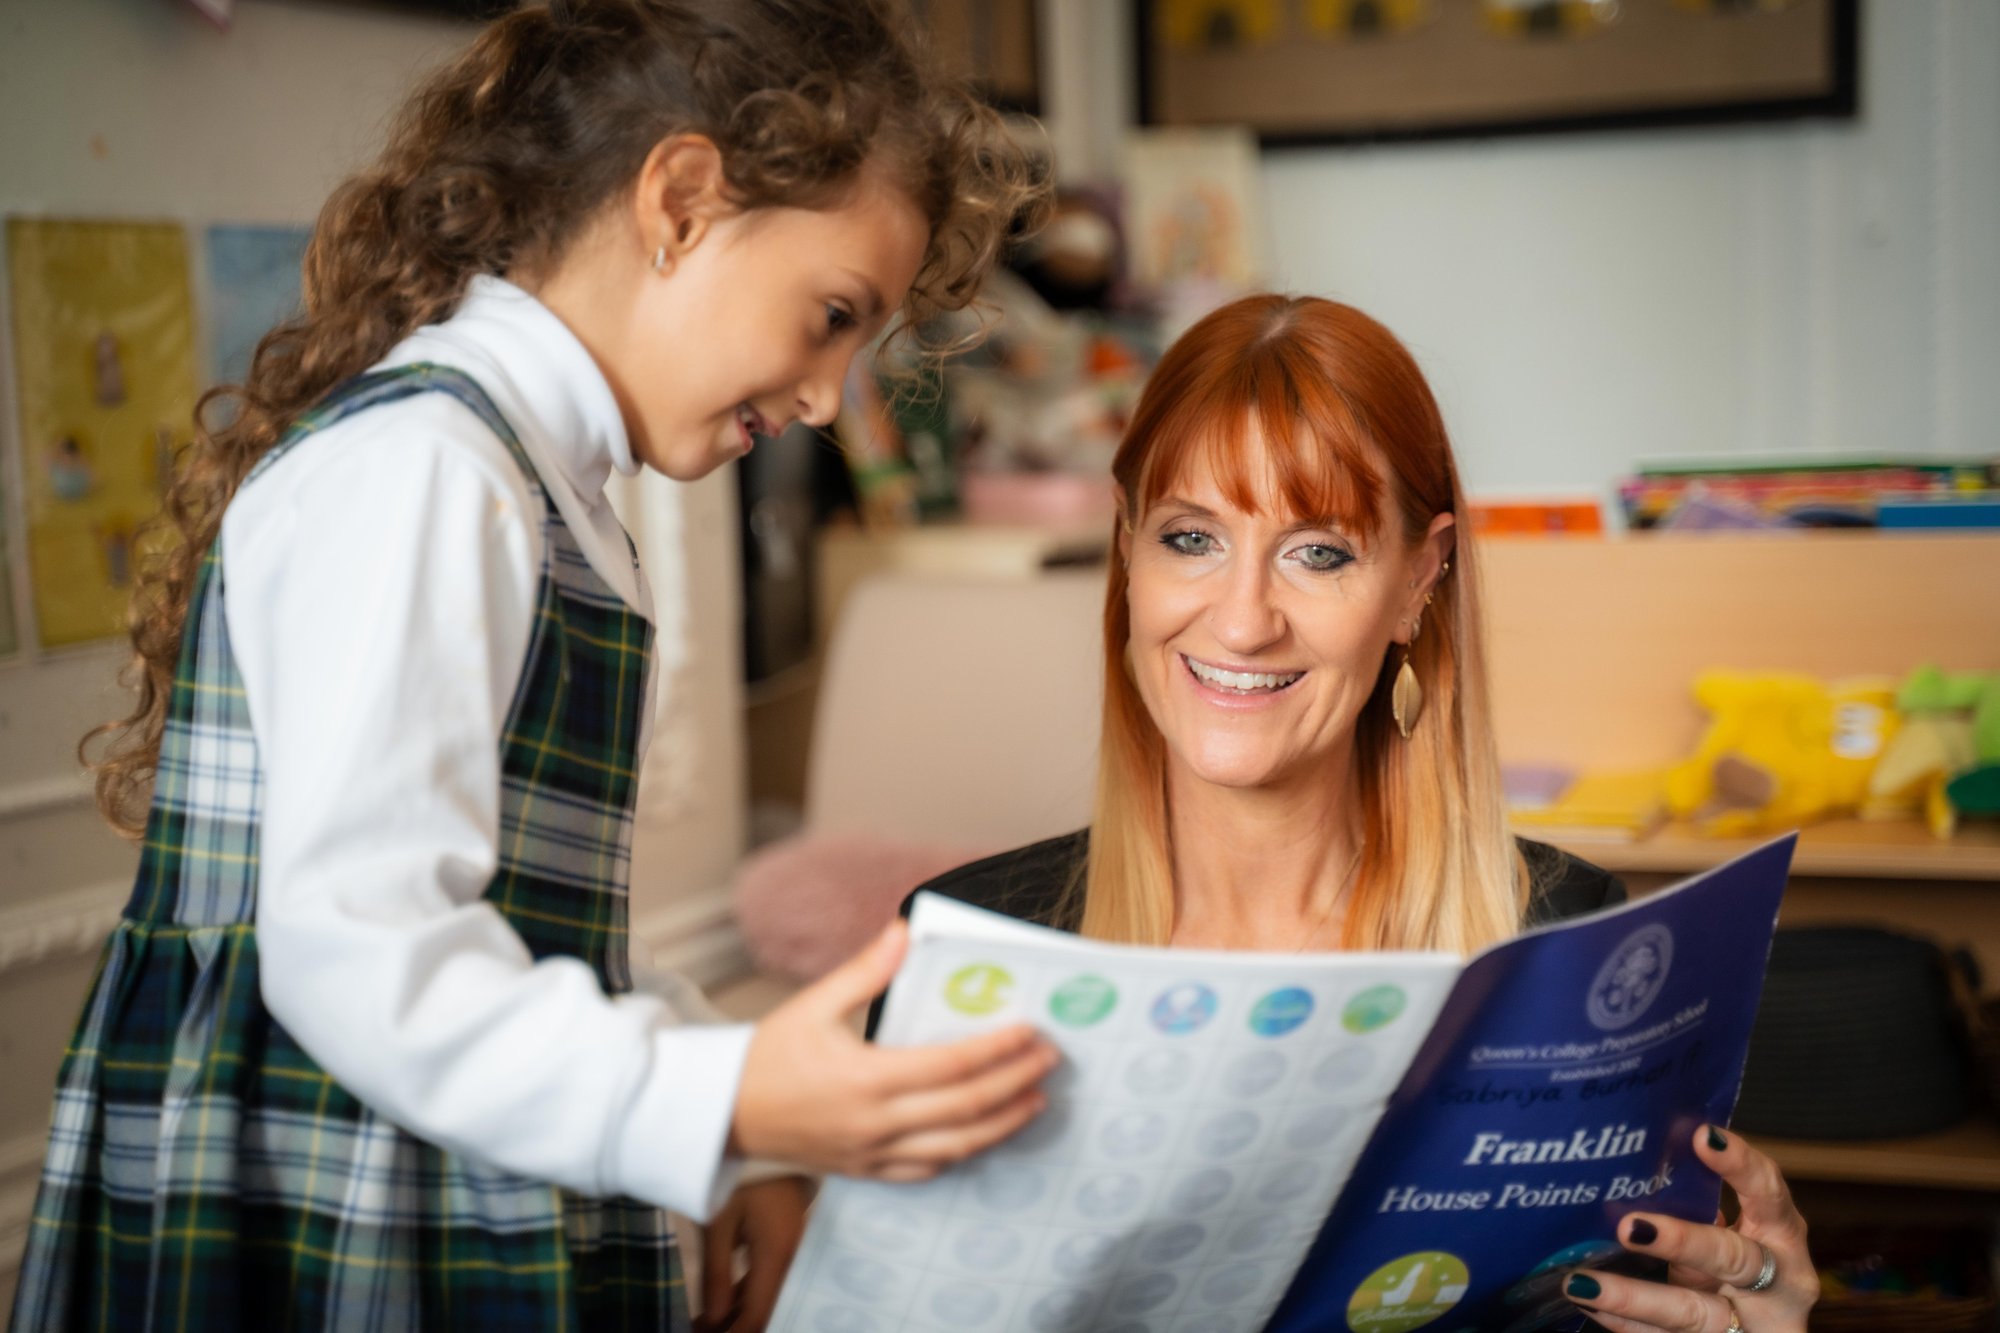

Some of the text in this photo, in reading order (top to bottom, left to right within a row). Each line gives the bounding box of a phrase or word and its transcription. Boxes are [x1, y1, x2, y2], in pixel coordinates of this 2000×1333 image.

[1463, 1124, 1648, 1166] Franklin
[1377, 1161, 1674, 1213] House Points Book
